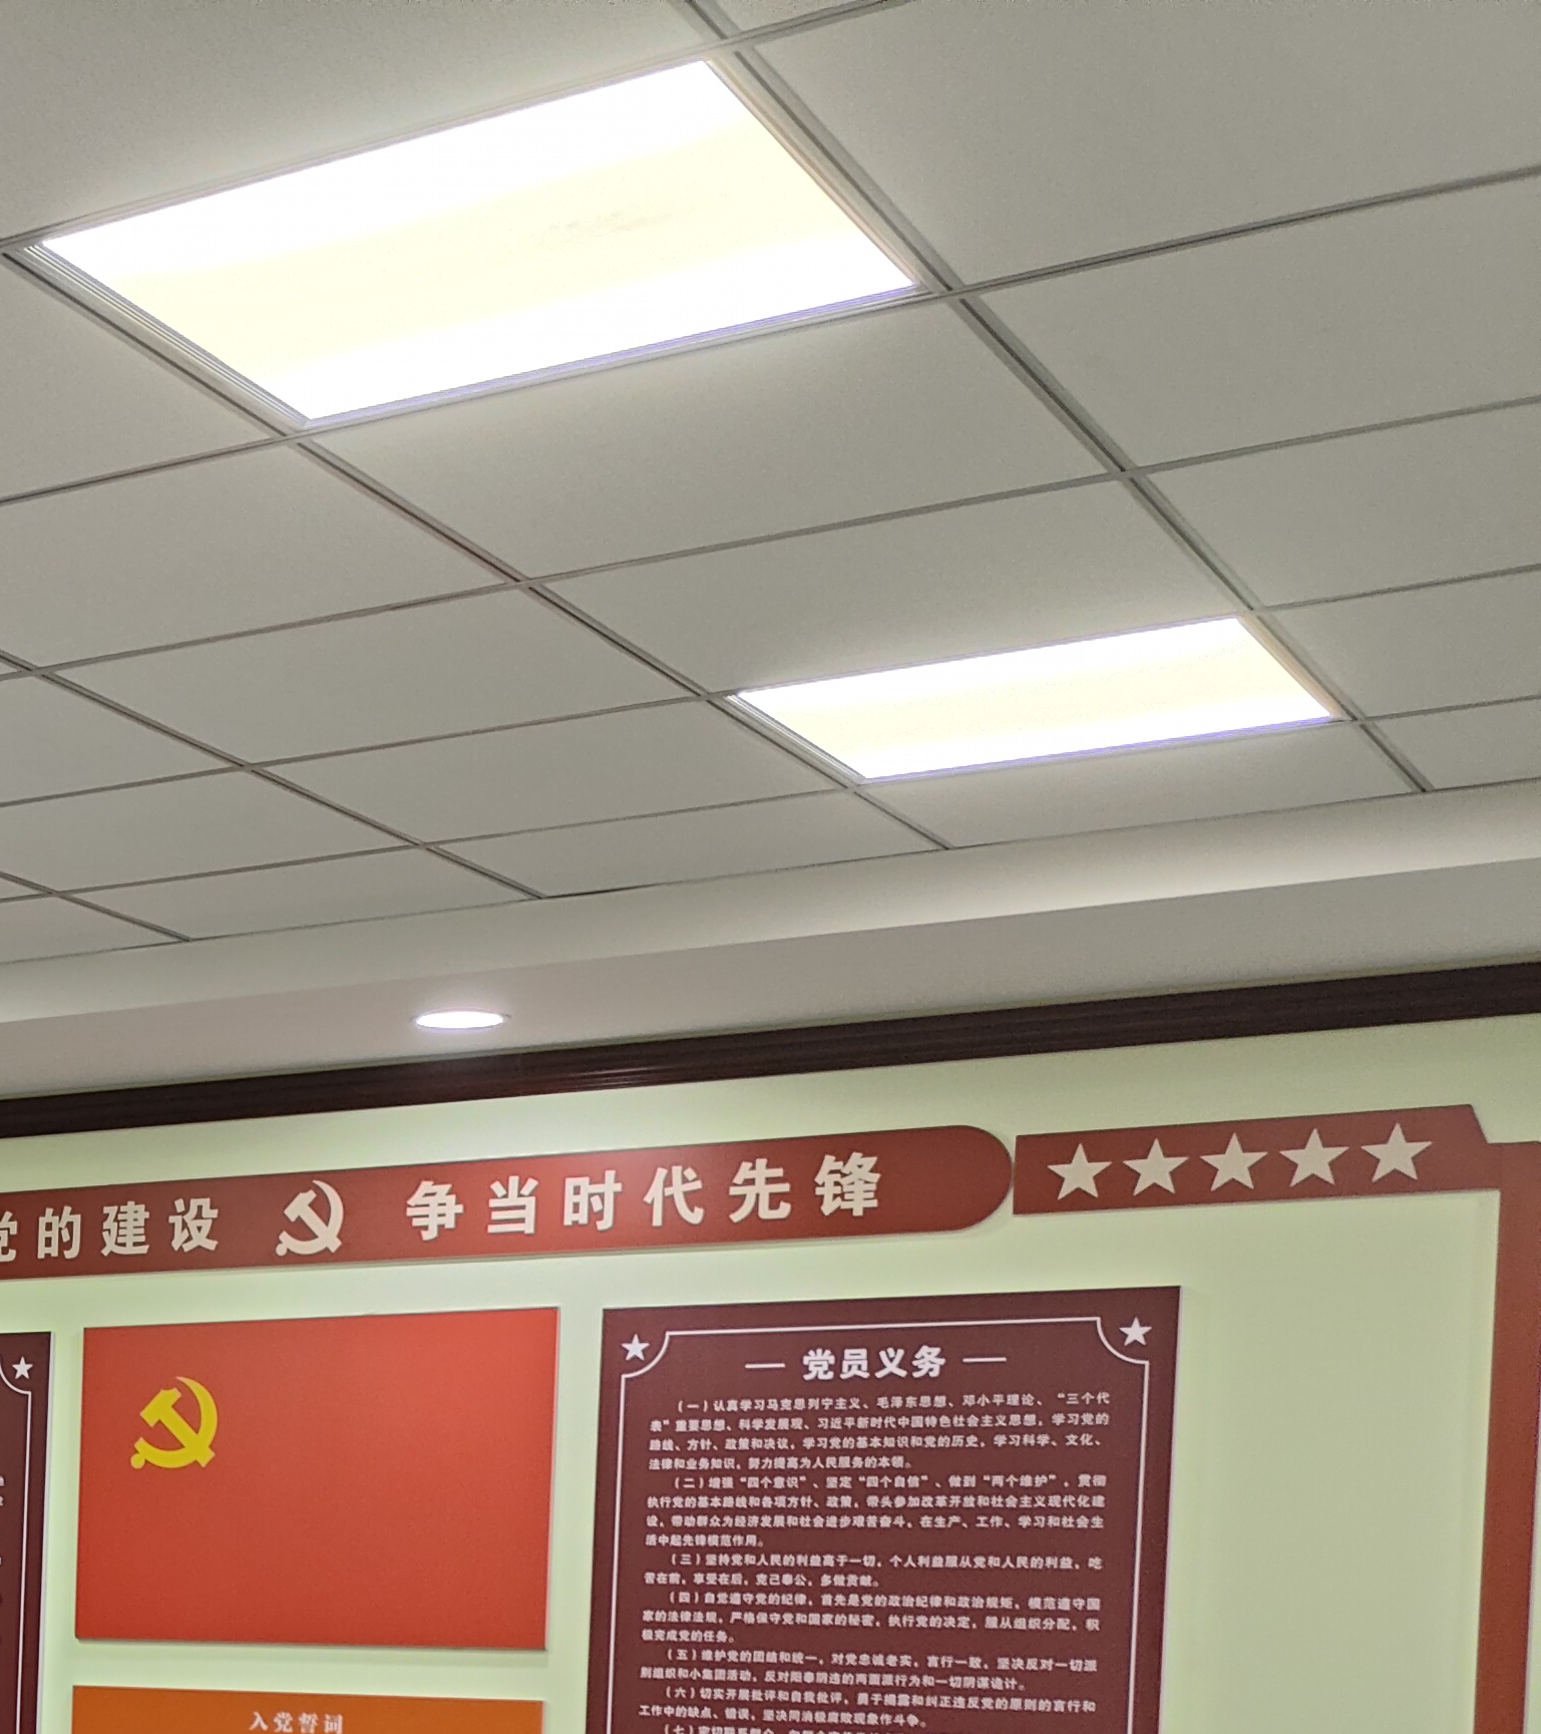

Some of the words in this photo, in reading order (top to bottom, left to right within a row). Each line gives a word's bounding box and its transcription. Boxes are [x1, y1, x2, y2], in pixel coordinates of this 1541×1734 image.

[407, 1151, 883, 1240] 争当时代先锋
[802, 1346, 946, 1380] 党员义务
[248, 1712, 344, 1734] 入党誓词
